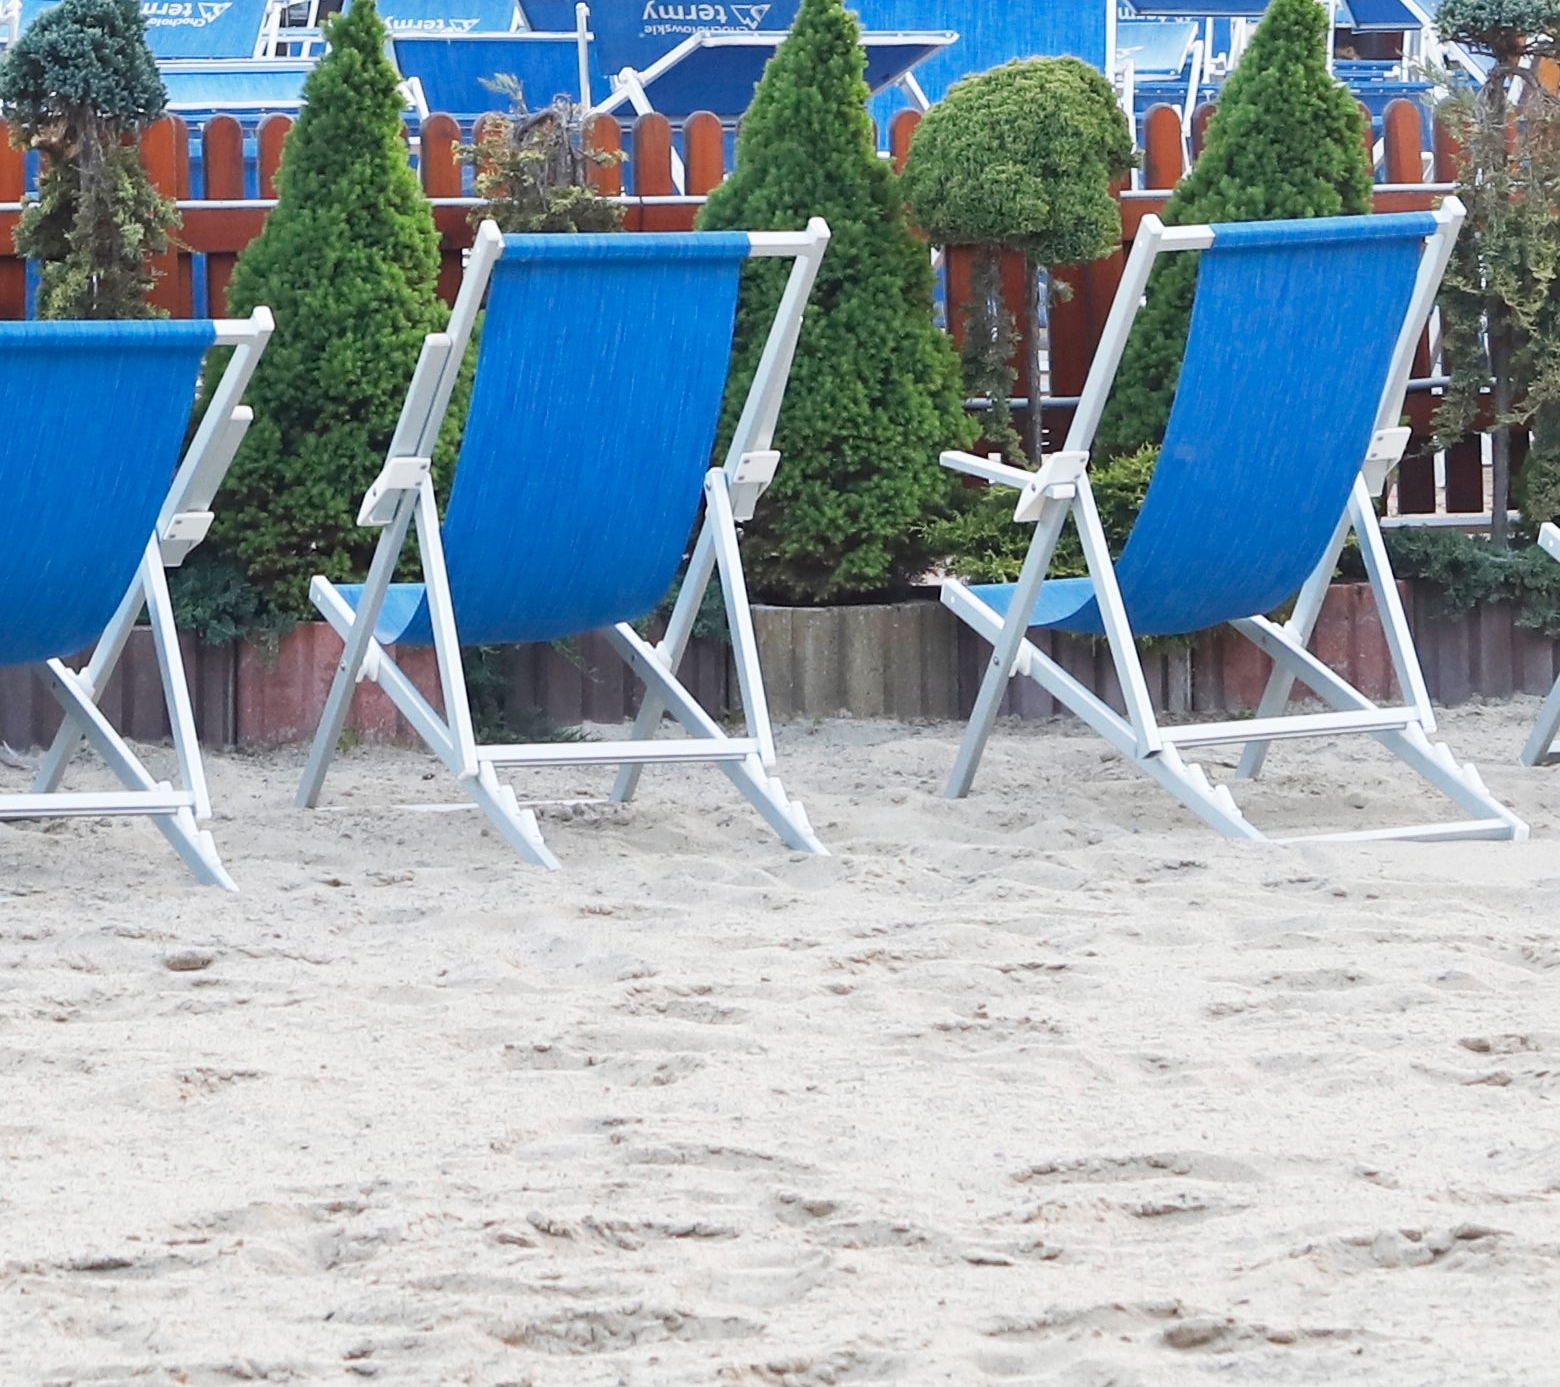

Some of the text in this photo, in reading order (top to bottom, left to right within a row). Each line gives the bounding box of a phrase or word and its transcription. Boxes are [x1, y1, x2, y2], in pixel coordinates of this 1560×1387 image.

[141, 2, 193, 17] term
[642, 0, 728, 24] termy
[383, 15, 446, 32] termy
